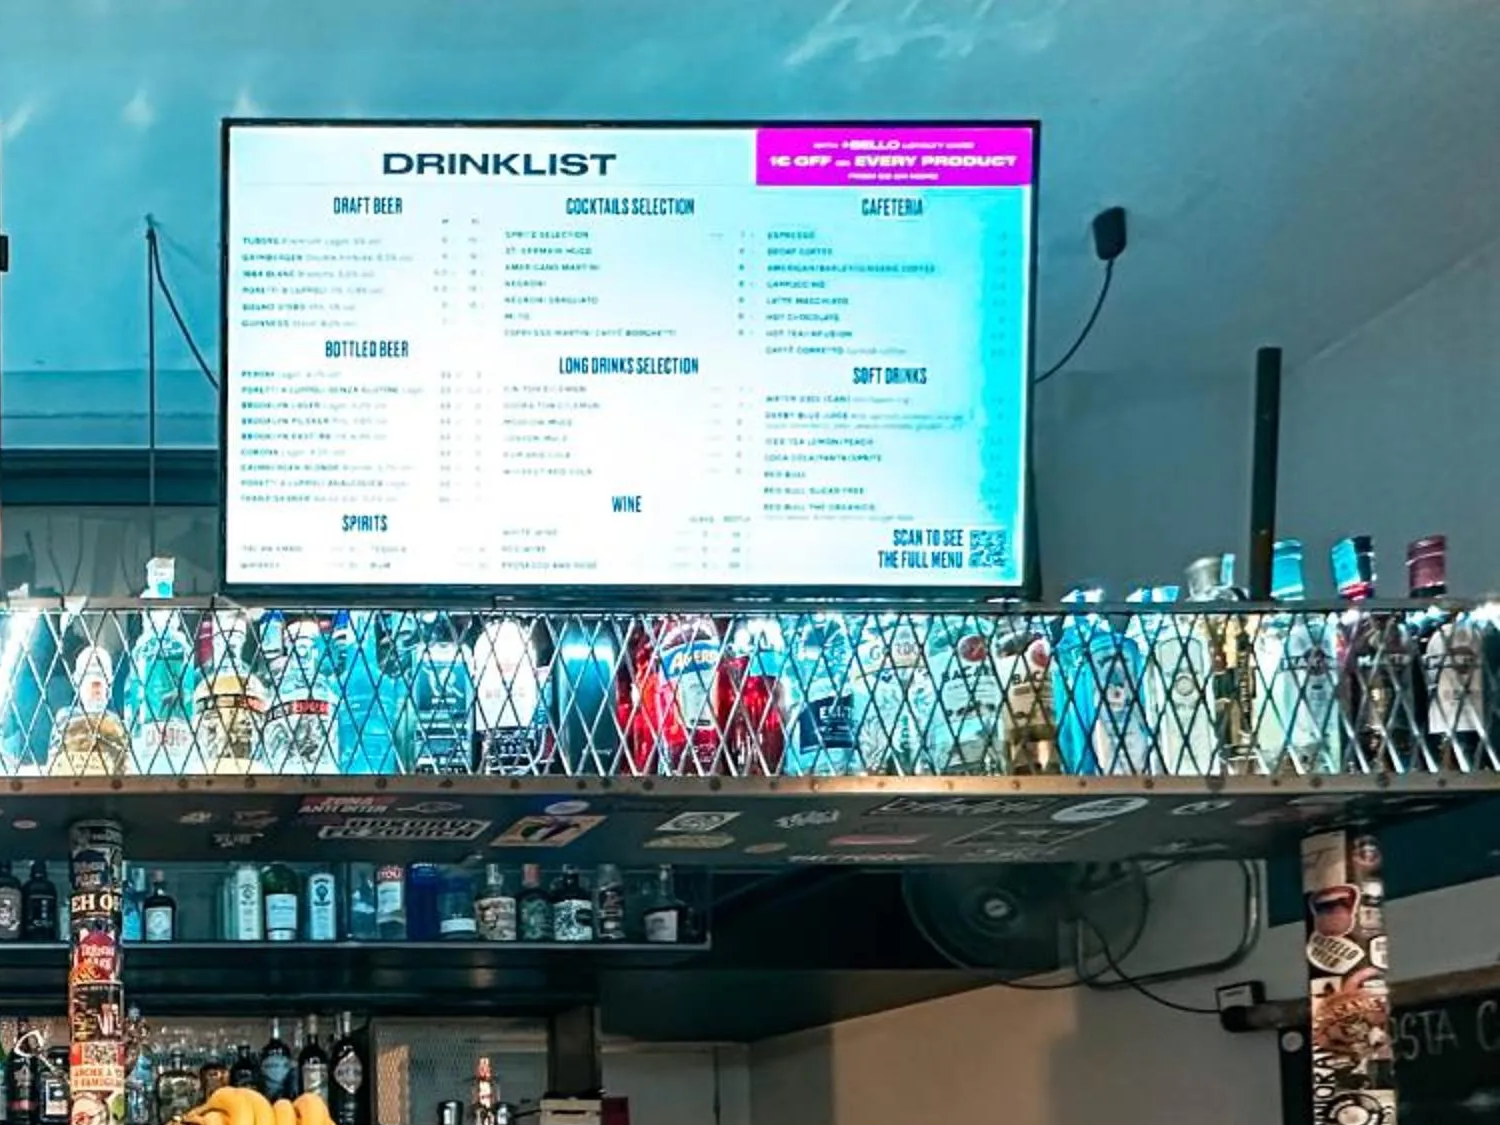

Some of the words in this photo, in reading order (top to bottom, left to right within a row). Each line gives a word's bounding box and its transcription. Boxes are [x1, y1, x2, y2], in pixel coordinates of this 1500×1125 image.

[383, 153, 616, 176] DRINKLIST
[794, 155, 832, 167] OFF
[854, 155, 917, 167] EVERY
[920, 155, 1018, 167] PRODUCT
[333, 197, 370, 215] DRAFT
[373, 197, 403, 215] BEER
[566, 197, 629, 215] COCKTAILS
[632, 197, 695, 215] SELECTION
[861, 197, 924, 216] CAFETERIA
[325, 341, 377, 357] BOTTLED
[379, 341, 409, 357] BEER
[559, 358, 588, 374] LONG
[591, 358, 633, 374] DRINKS
[636, 358, 699, 374] SELECTION
[853, 368, 882, 384] SOFT
[885, 368, 927, 384] DRINKS
[611, 495, 642, 513] WINE
[342, 514, 388, 532] SPIRITS
[893, 530, 922, 546] SCAN
[925, 530, 940, 546] TO
[943, 530, 964, 546] SEE
[878, 551, 899, 568] THE
[901, 551, 928, 568] FULL
[931, 551, 963, 568] MENU
